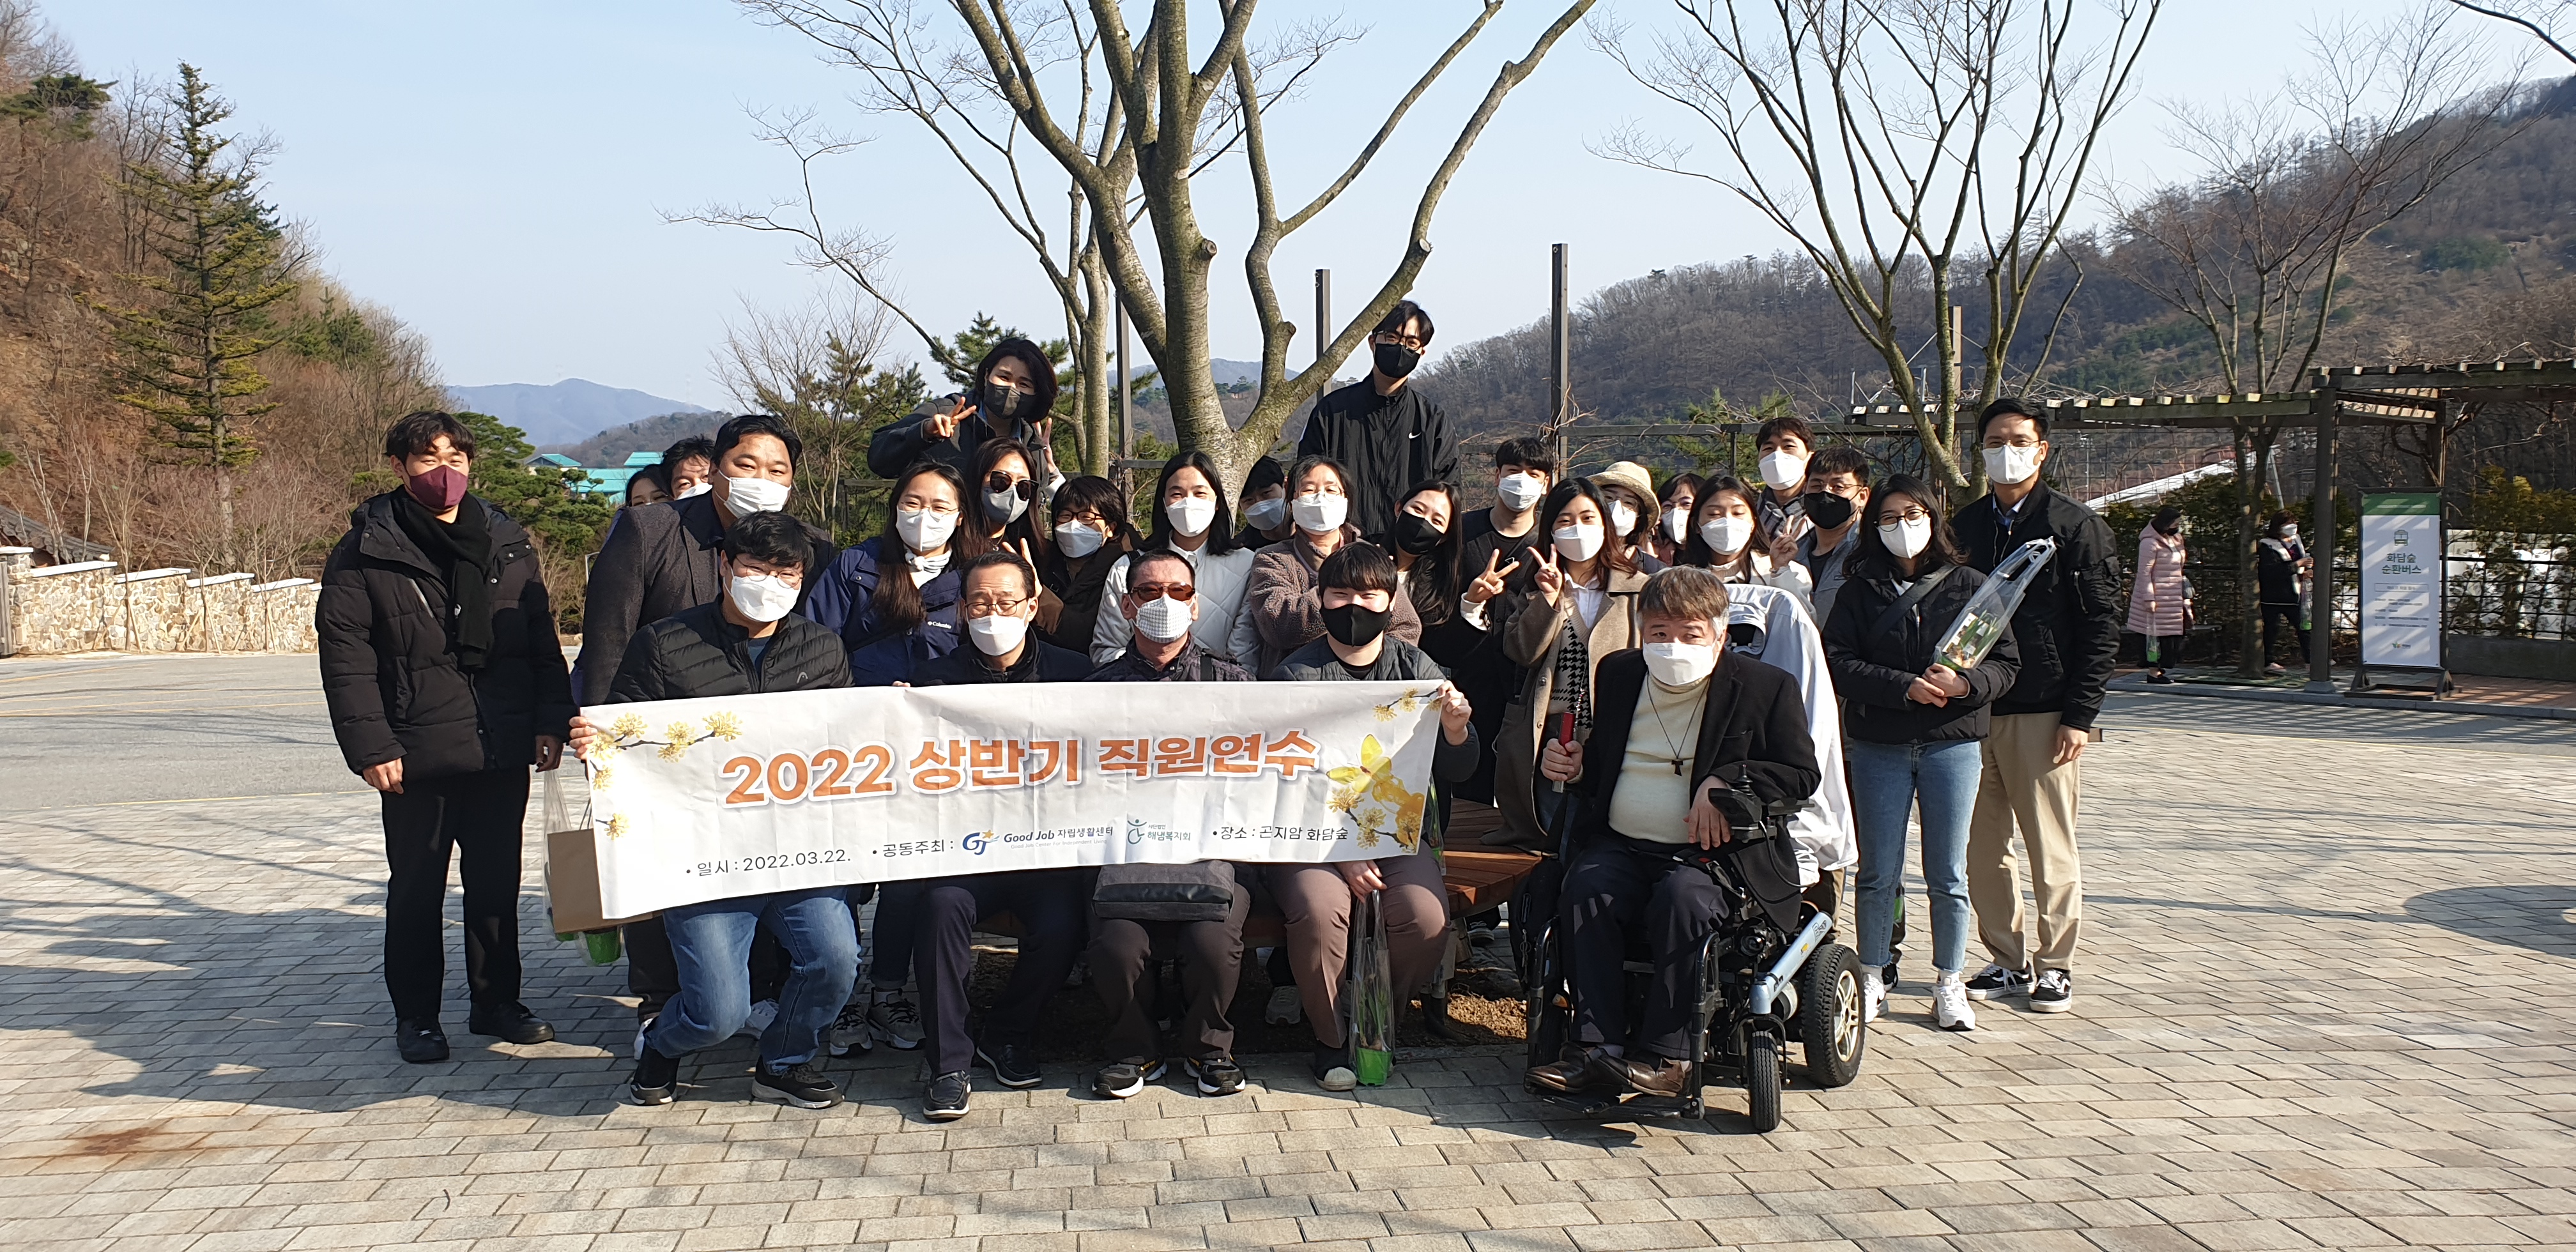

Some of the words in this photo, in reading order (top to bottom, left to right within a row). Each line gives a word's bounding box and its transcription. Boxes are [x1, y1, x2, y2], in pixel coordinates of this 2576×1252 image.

[2387, 553, 2416, 563] 화담숲
[2382, 565, 2421, 574] 순환버스
[933, 621, 952, 629] Columbia
[723, 745, 893, 804] 2022
[910, 739, 1078, 790] 상반기
[1098, 730, 1317, 777] 직원연수
[1004, 832, 1033, 843] Good
[1035, 830, 1055, 841] Job
[1057, 827, 1114, 839] 자립생활센터
[1147, 831, 1191, 841] 해냄복지회
[1259, 826, 1303, 840] 곤지암
[1306, 826, 1349, 841] 화담숲
